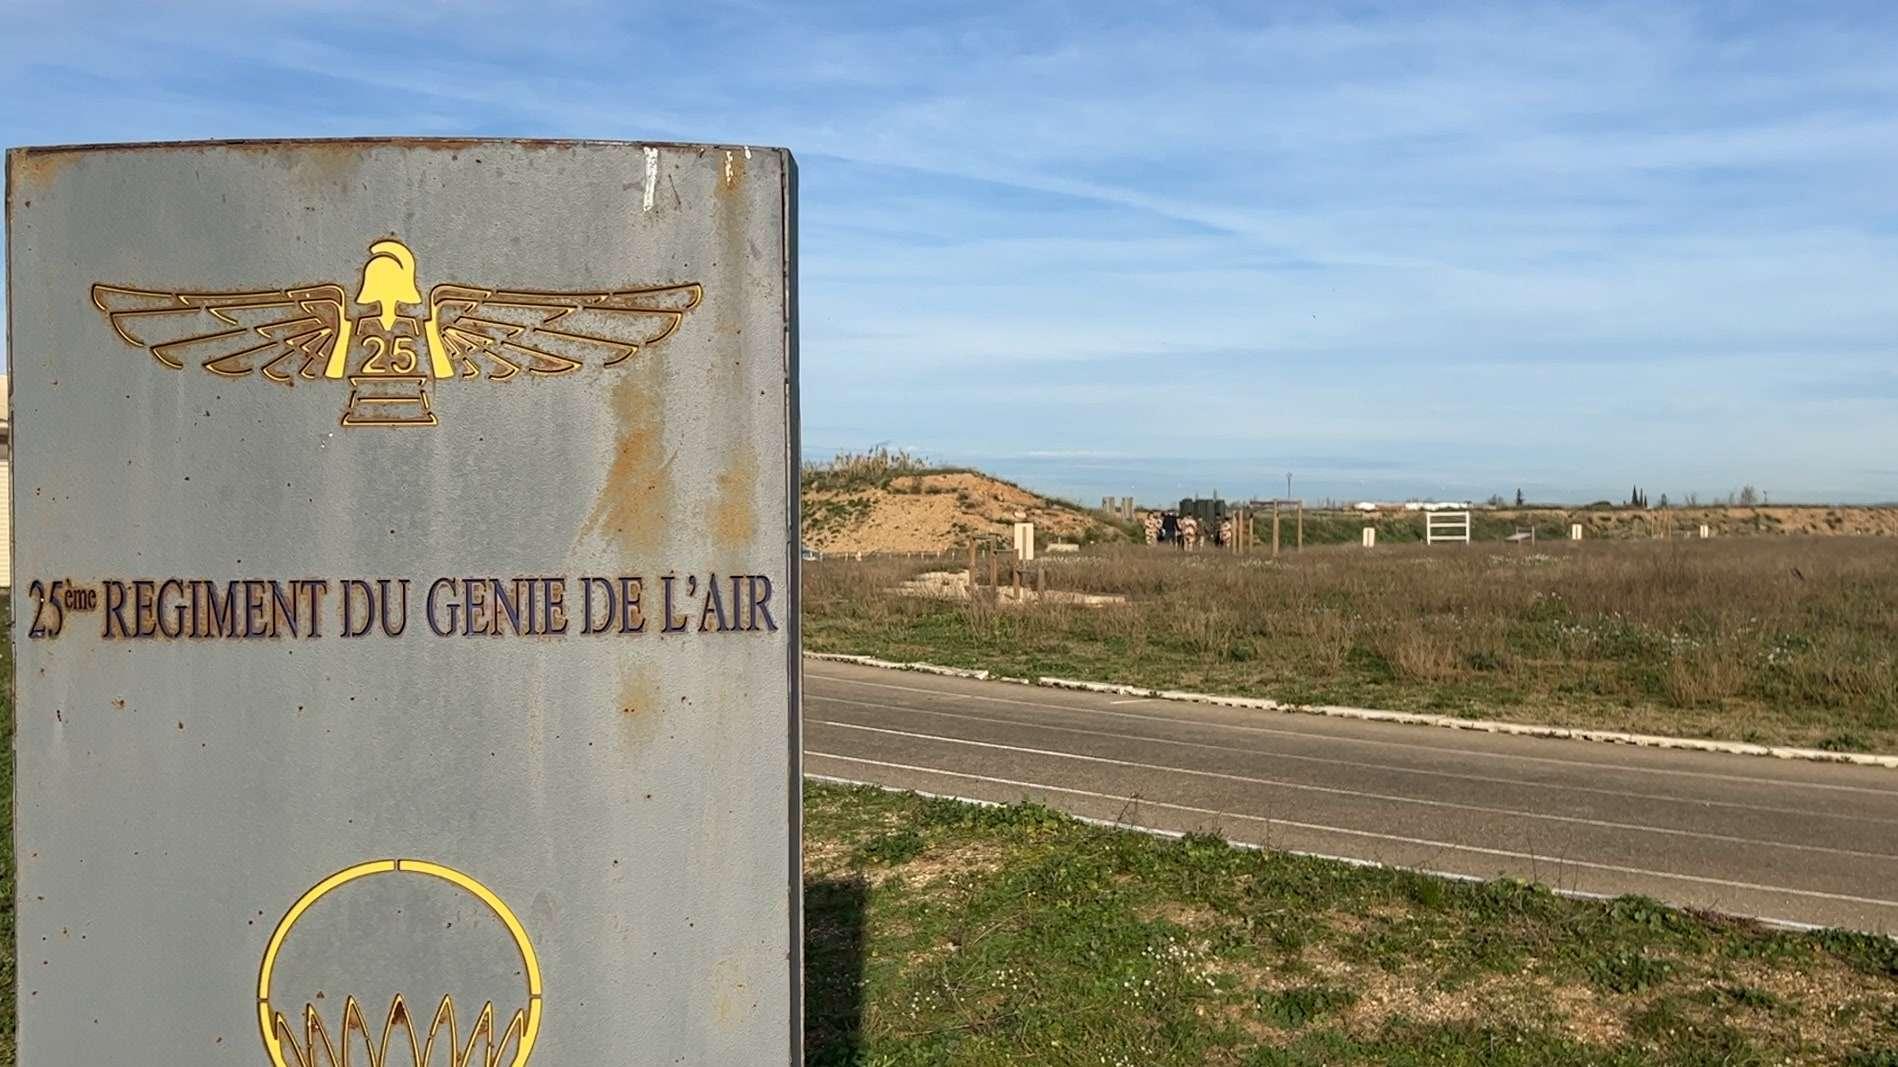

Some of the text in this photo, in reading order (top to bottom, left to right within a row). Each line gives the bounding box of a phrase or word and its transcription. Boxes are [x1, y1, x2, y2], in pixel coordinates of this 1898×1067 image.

[361, 335, 417, 374] 25
[101, 578, 327, 640] REGIMENT
[340, 578, 411, 639] DU
[426, 576, 569, 638] GENIE
[581, 576, 646, 636] DE
[660, 572, 779, 634] L'AIR
